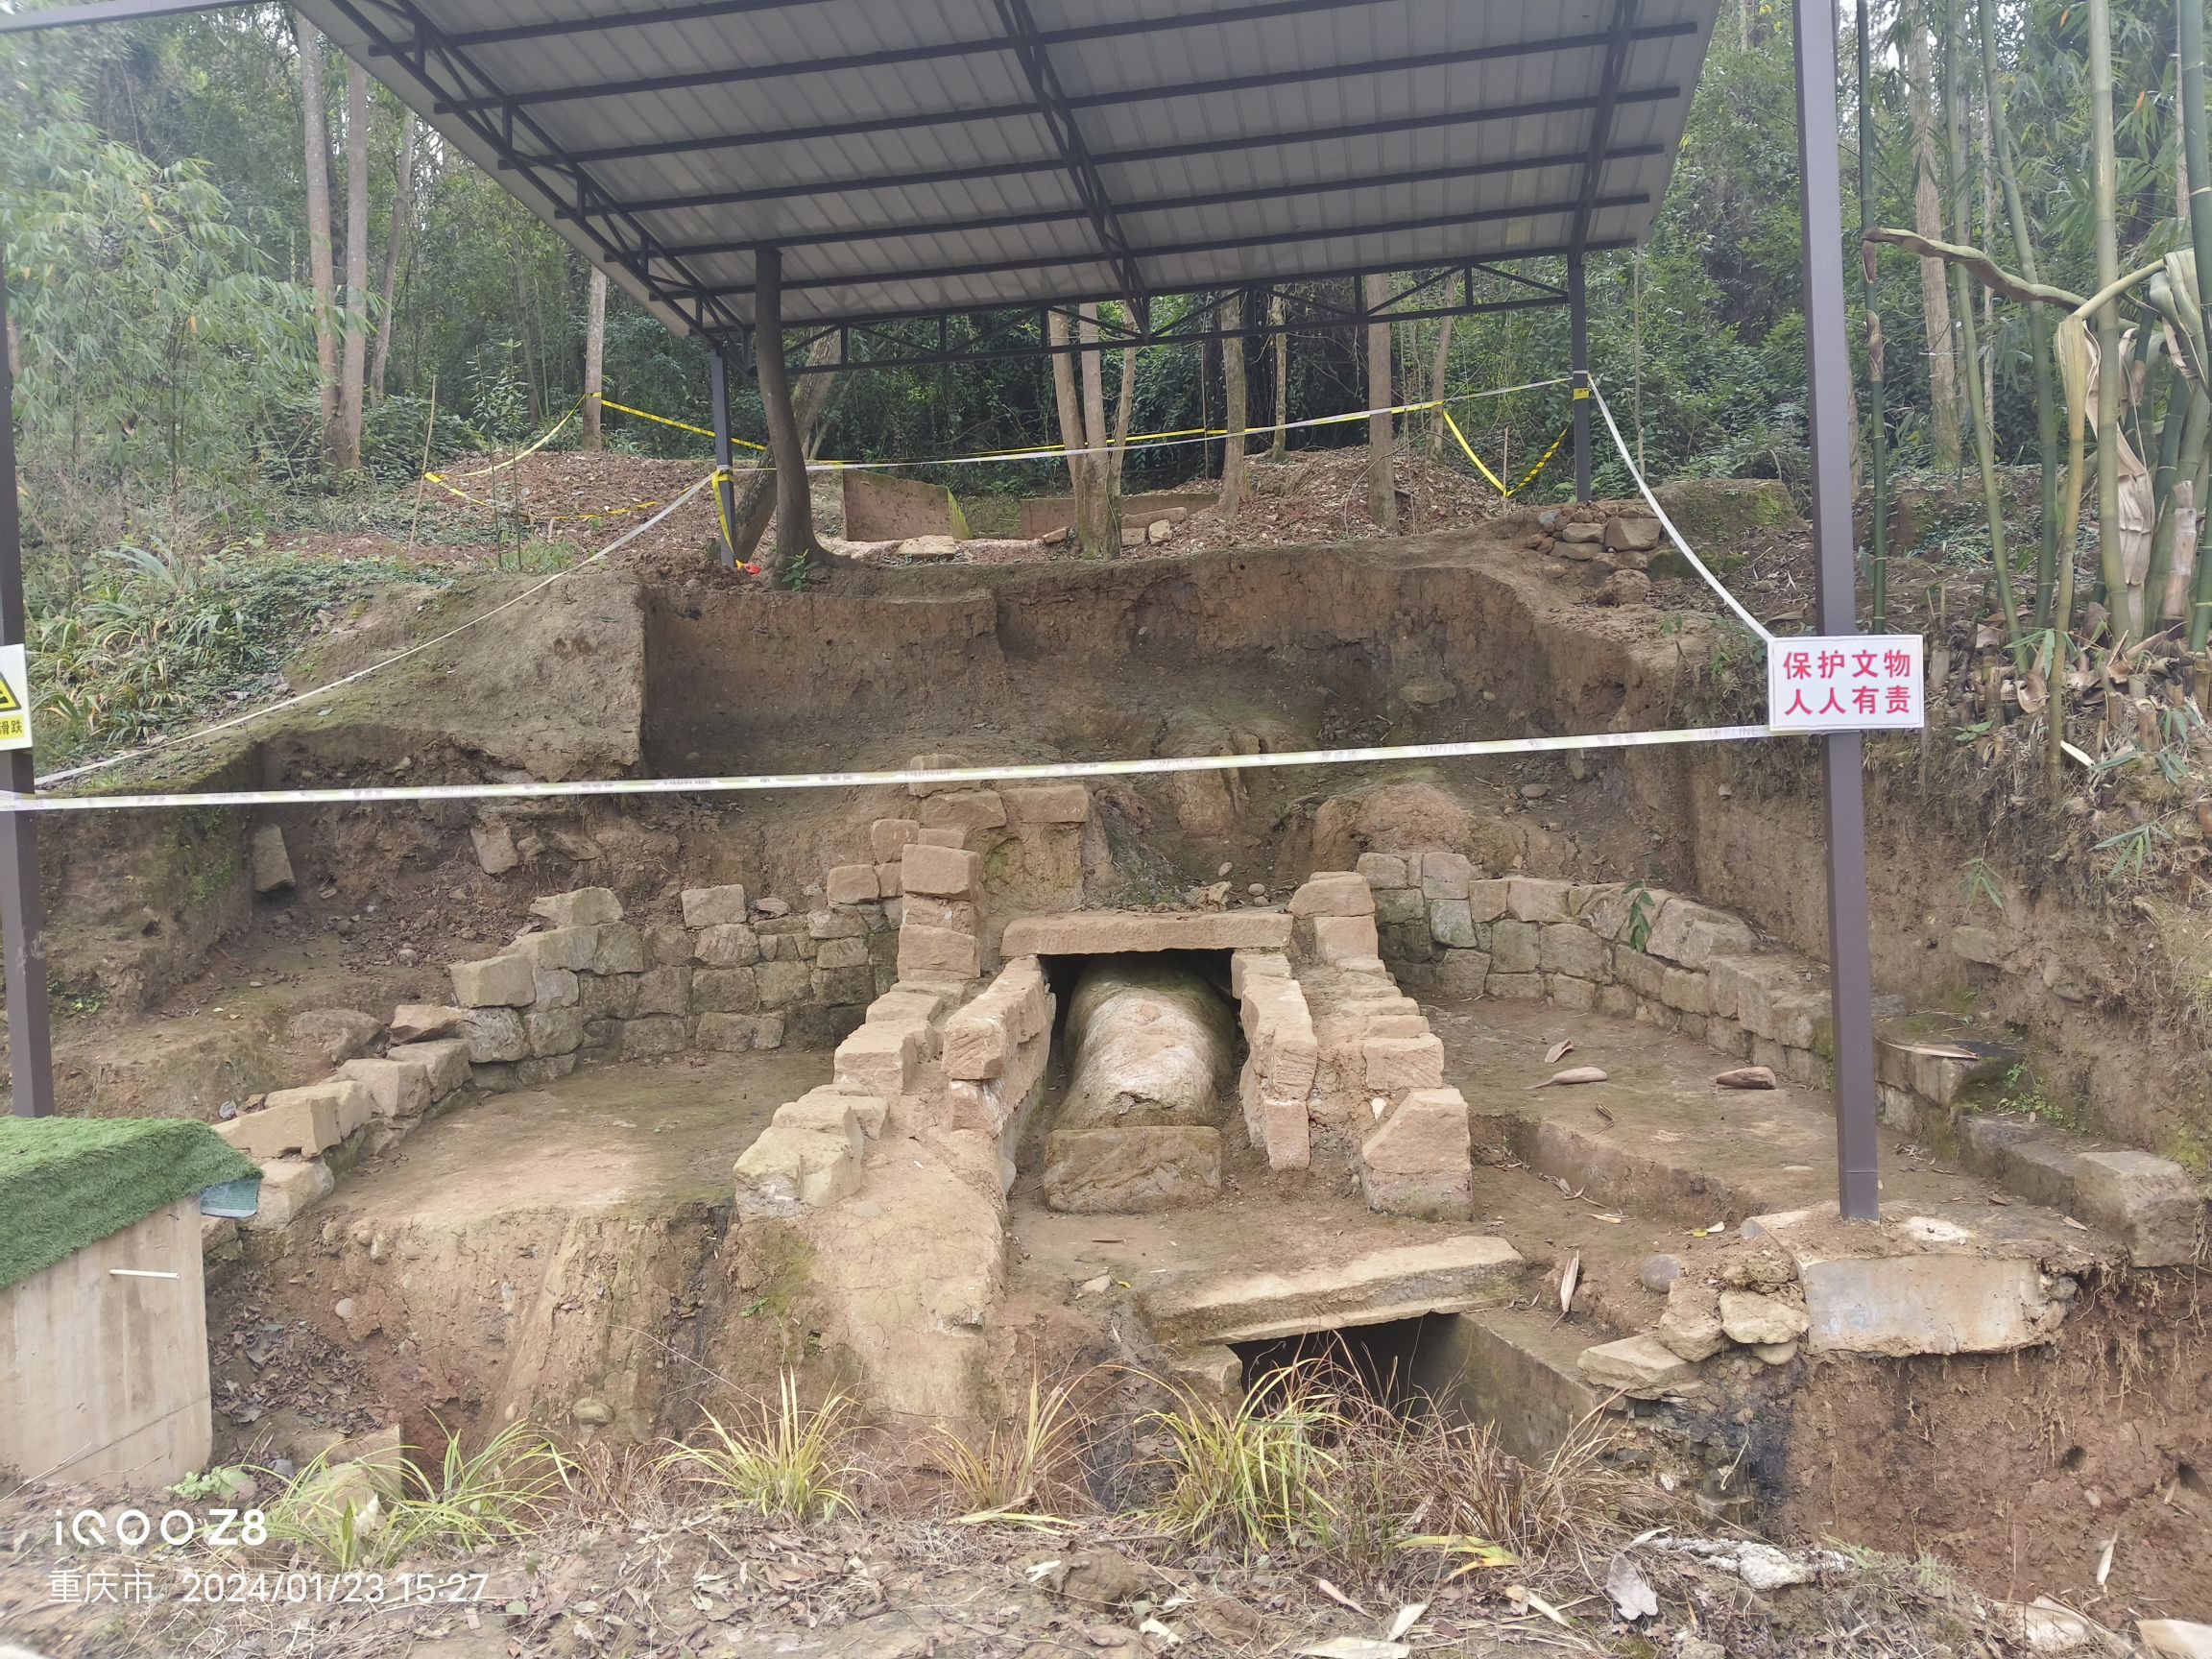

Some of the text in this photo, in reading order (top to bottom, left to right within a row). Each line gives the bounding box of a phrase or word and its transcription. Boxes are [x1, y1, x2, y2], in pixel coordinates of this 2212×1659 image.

[1783, 649, 1911, 680] 保护文物
[1785, 685, 1911, 715] 人人有责
